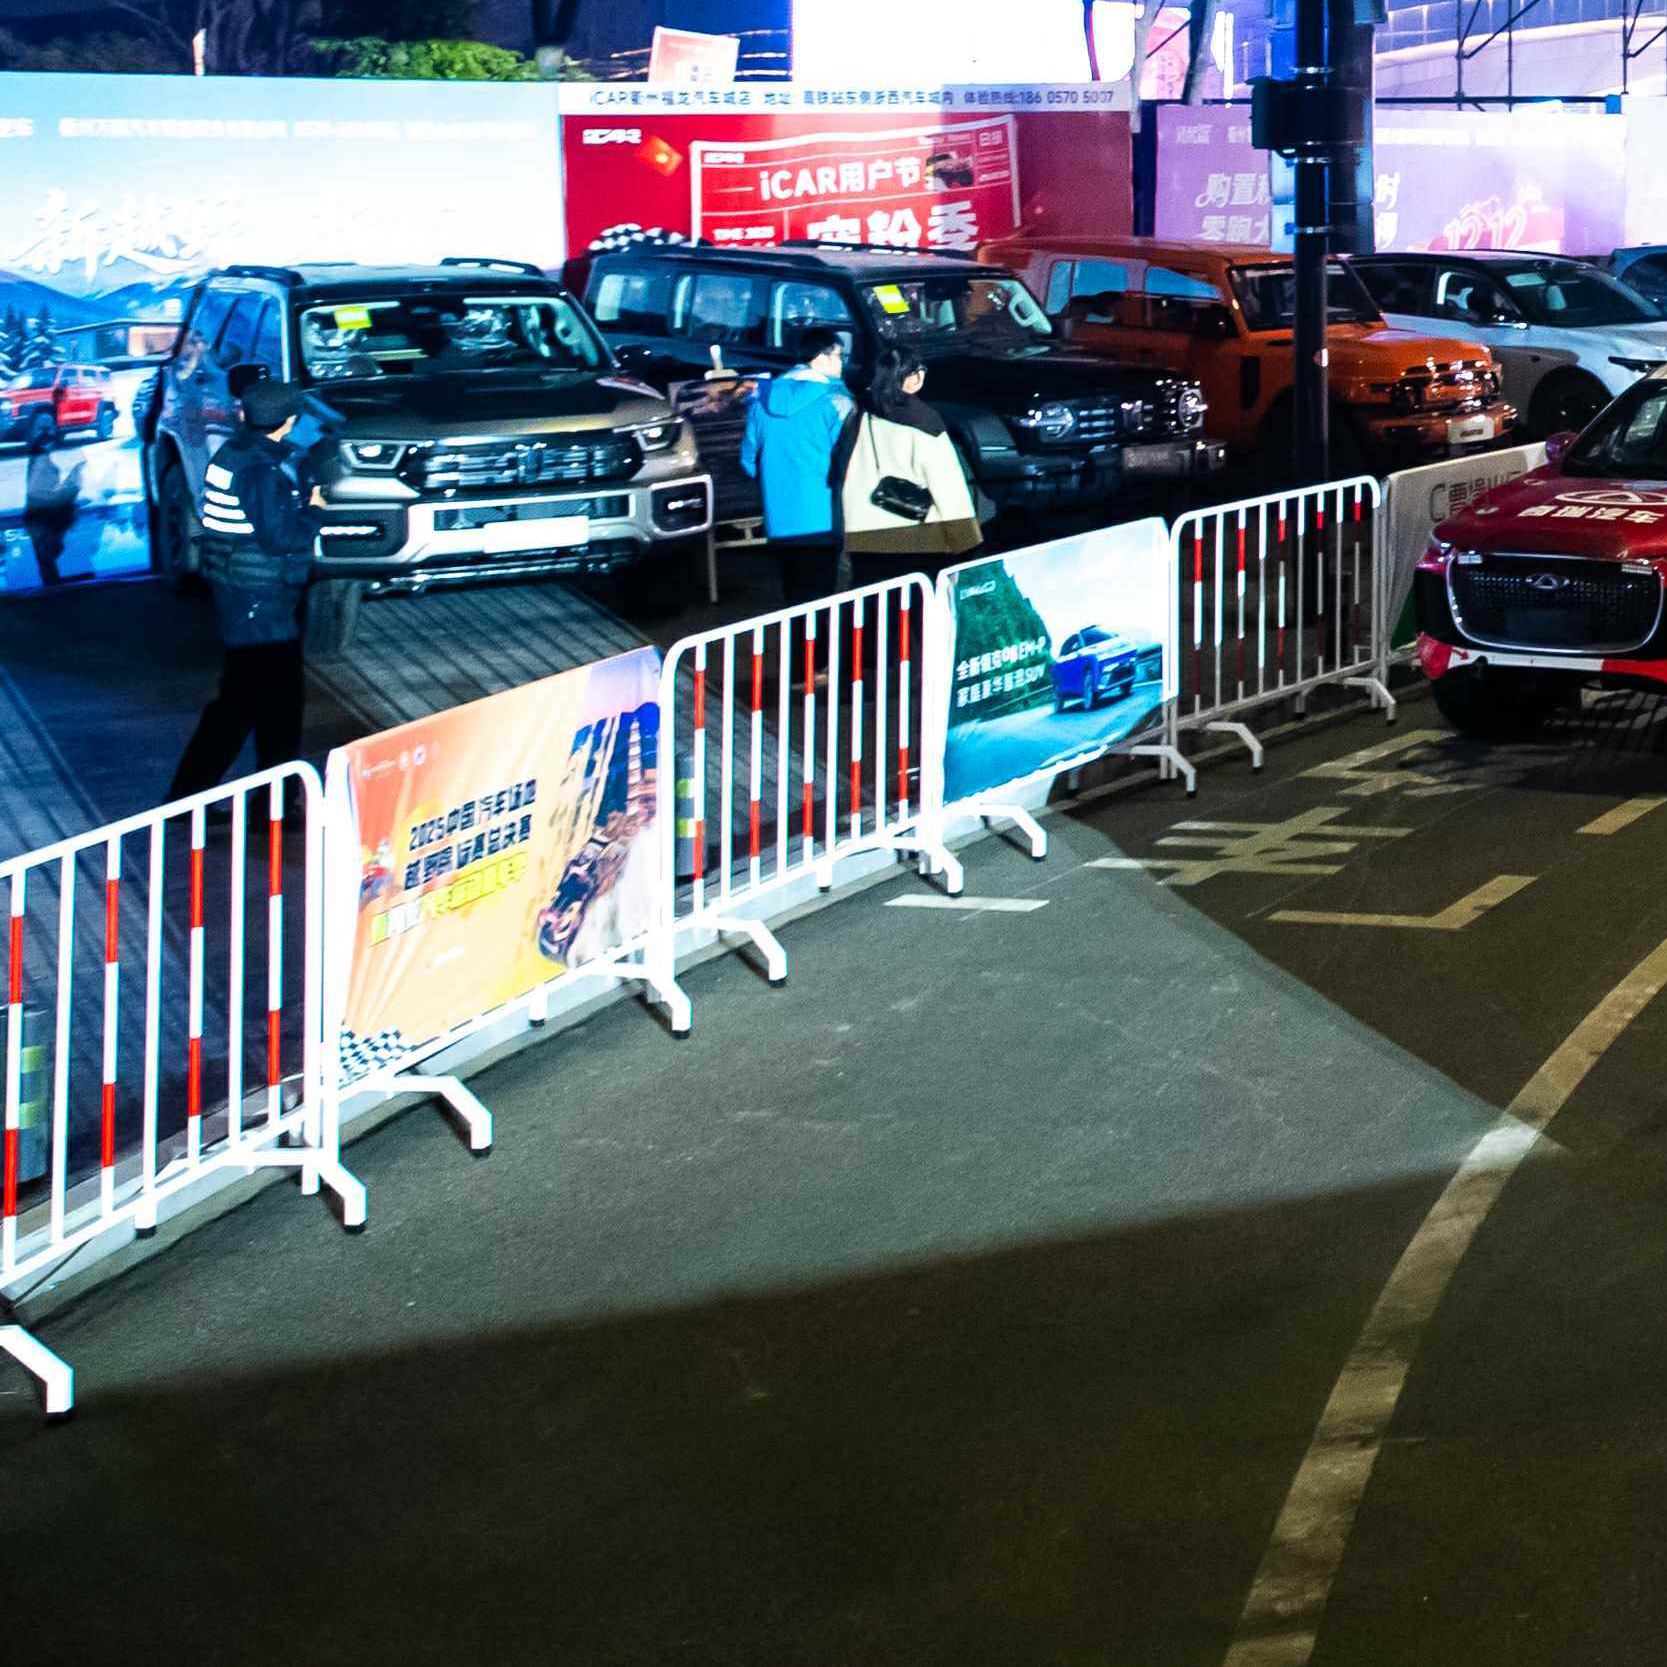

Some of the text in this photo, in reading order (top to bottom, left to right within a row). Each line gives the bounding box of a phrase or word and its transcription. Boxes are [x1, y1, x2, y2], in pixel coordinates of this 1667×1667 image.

[1046, 88, 1079, 105] 0570
[759, 156, 922, 202] iCAR用户节
